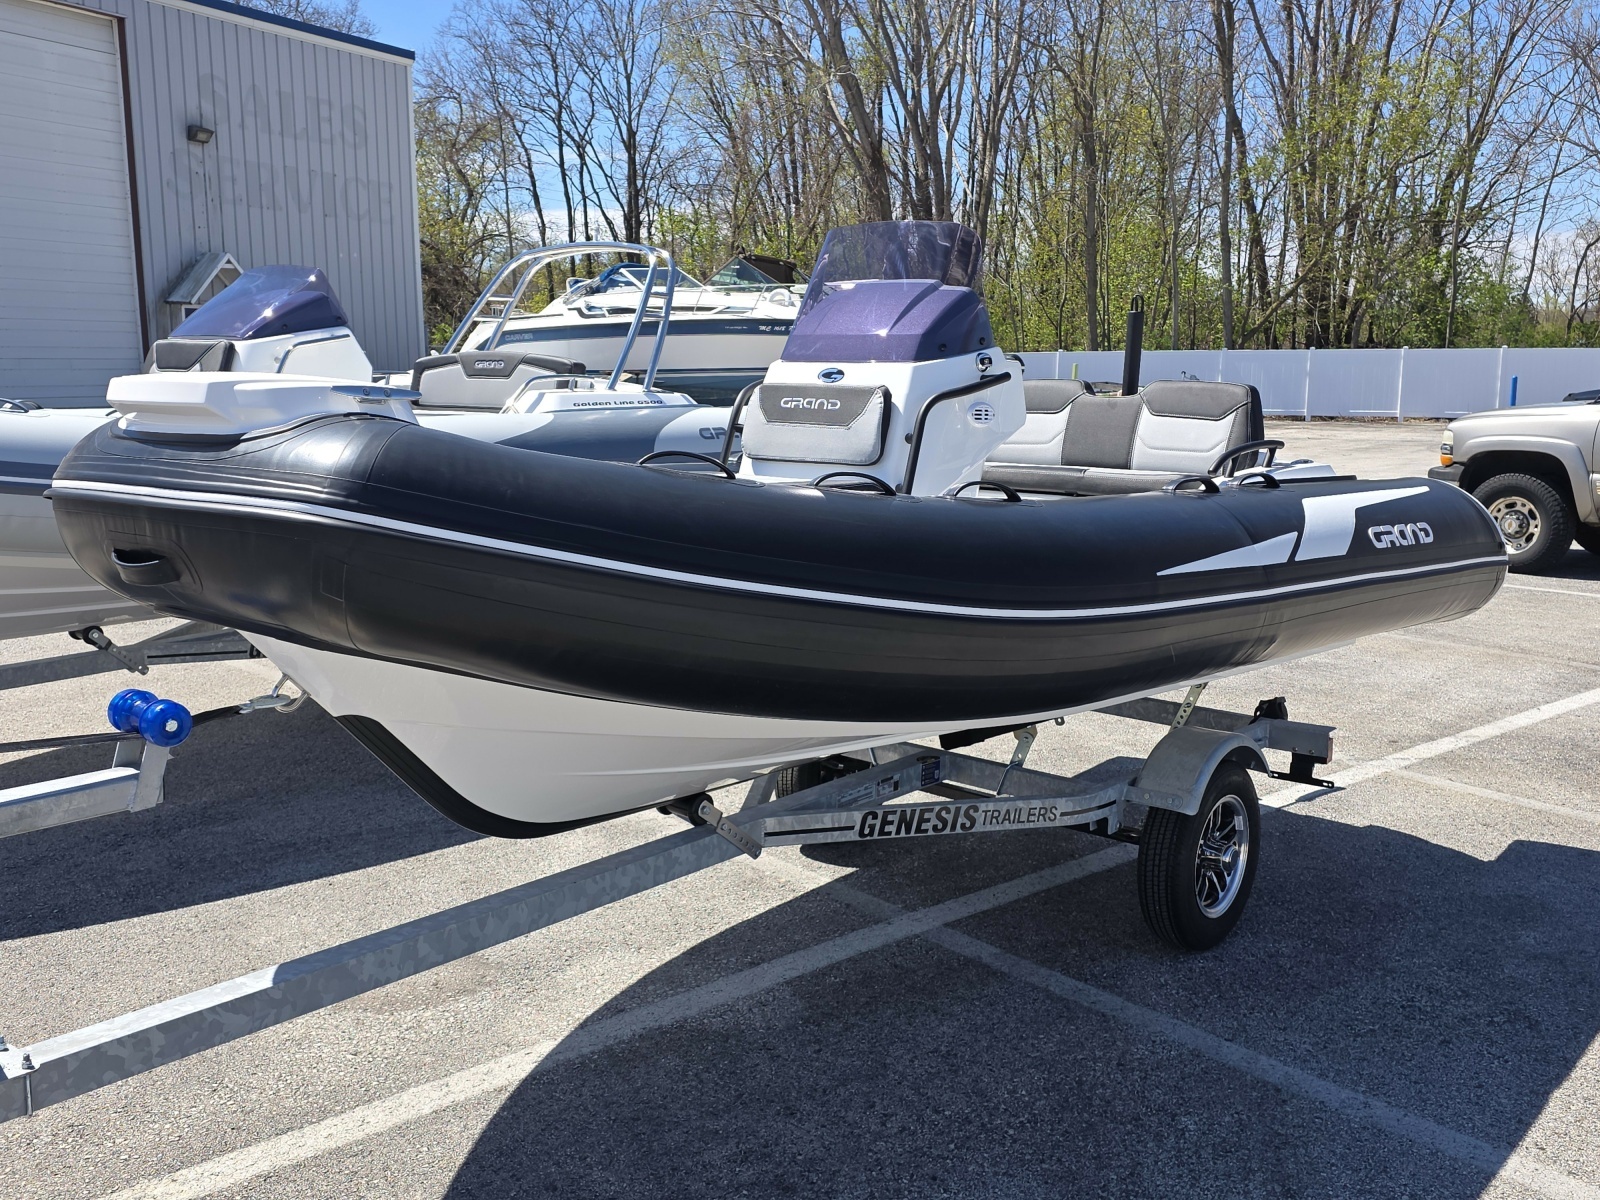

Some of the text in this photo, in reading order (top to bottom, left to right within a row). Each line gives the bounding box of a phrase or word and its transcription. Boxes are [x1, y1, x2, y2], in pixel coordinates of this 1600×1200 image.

[198, 72, 368, 150] SALES
[166, 147, 394, 224] SERVICE
[504, 332, 533, 341] CARVER
[474, 361, 505, 369] GRAND
[780, 397, 841, 410] GRAND
[1368, 521, 1434, 549] GRAND
[858, 804, 1058, 839] GENESIS TRAILERS
